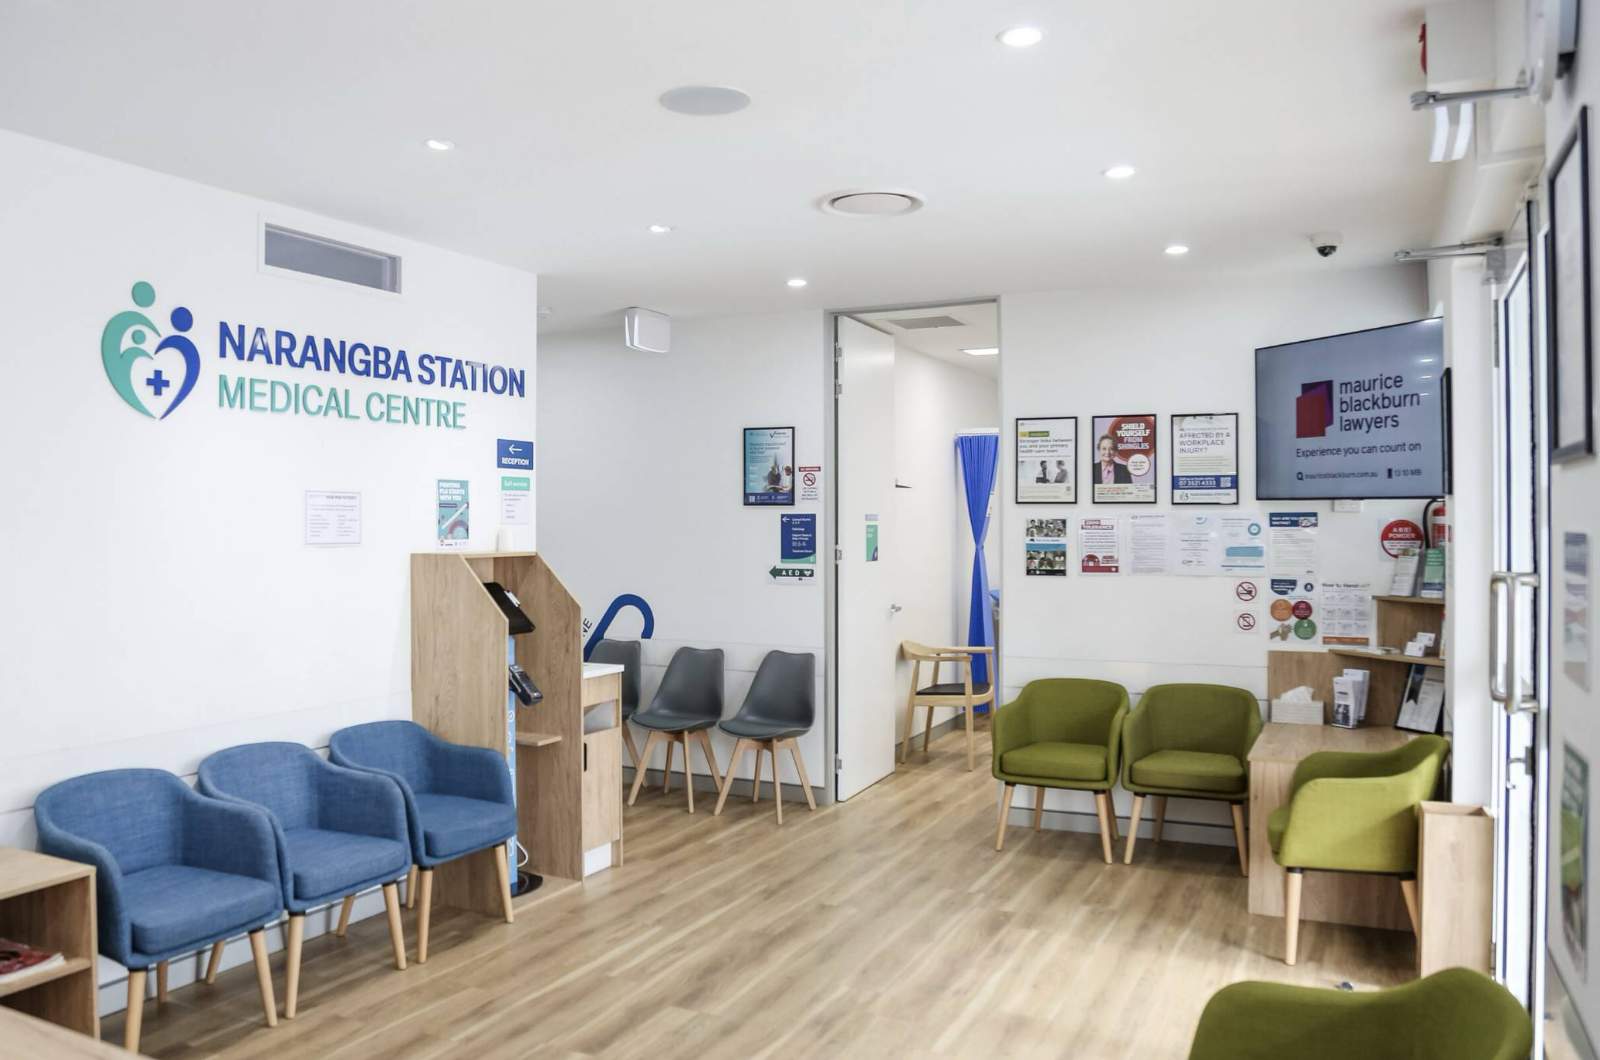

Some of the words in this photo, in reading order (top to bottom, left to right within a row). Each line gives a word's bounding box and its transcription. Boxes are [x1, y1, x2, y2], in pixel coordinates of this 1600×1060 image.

[219, 321, 412, 383] NARANGBA
[418, 353, 525, 398] STATION
[1339, 374, 1403, 394] maurice
[218, 374, 360, 420] MEDICAL
[365, 391, 466, 429] CENTRE
[1340, 392, 1420, 413] blackburn
[1116, 429, 1151, 437] YOURSELF
[1340, 414, 1399, 433] lawyers
[1296, 447, 1341, 458] Experience
[1343, 446, 1359, 457] you
[1361, 445, 1377, 454] can
[1379, 443, 1406, 453] count
[1409, 442, 1421, 451] on
[502, 457, 529, 465] RECEPTION
